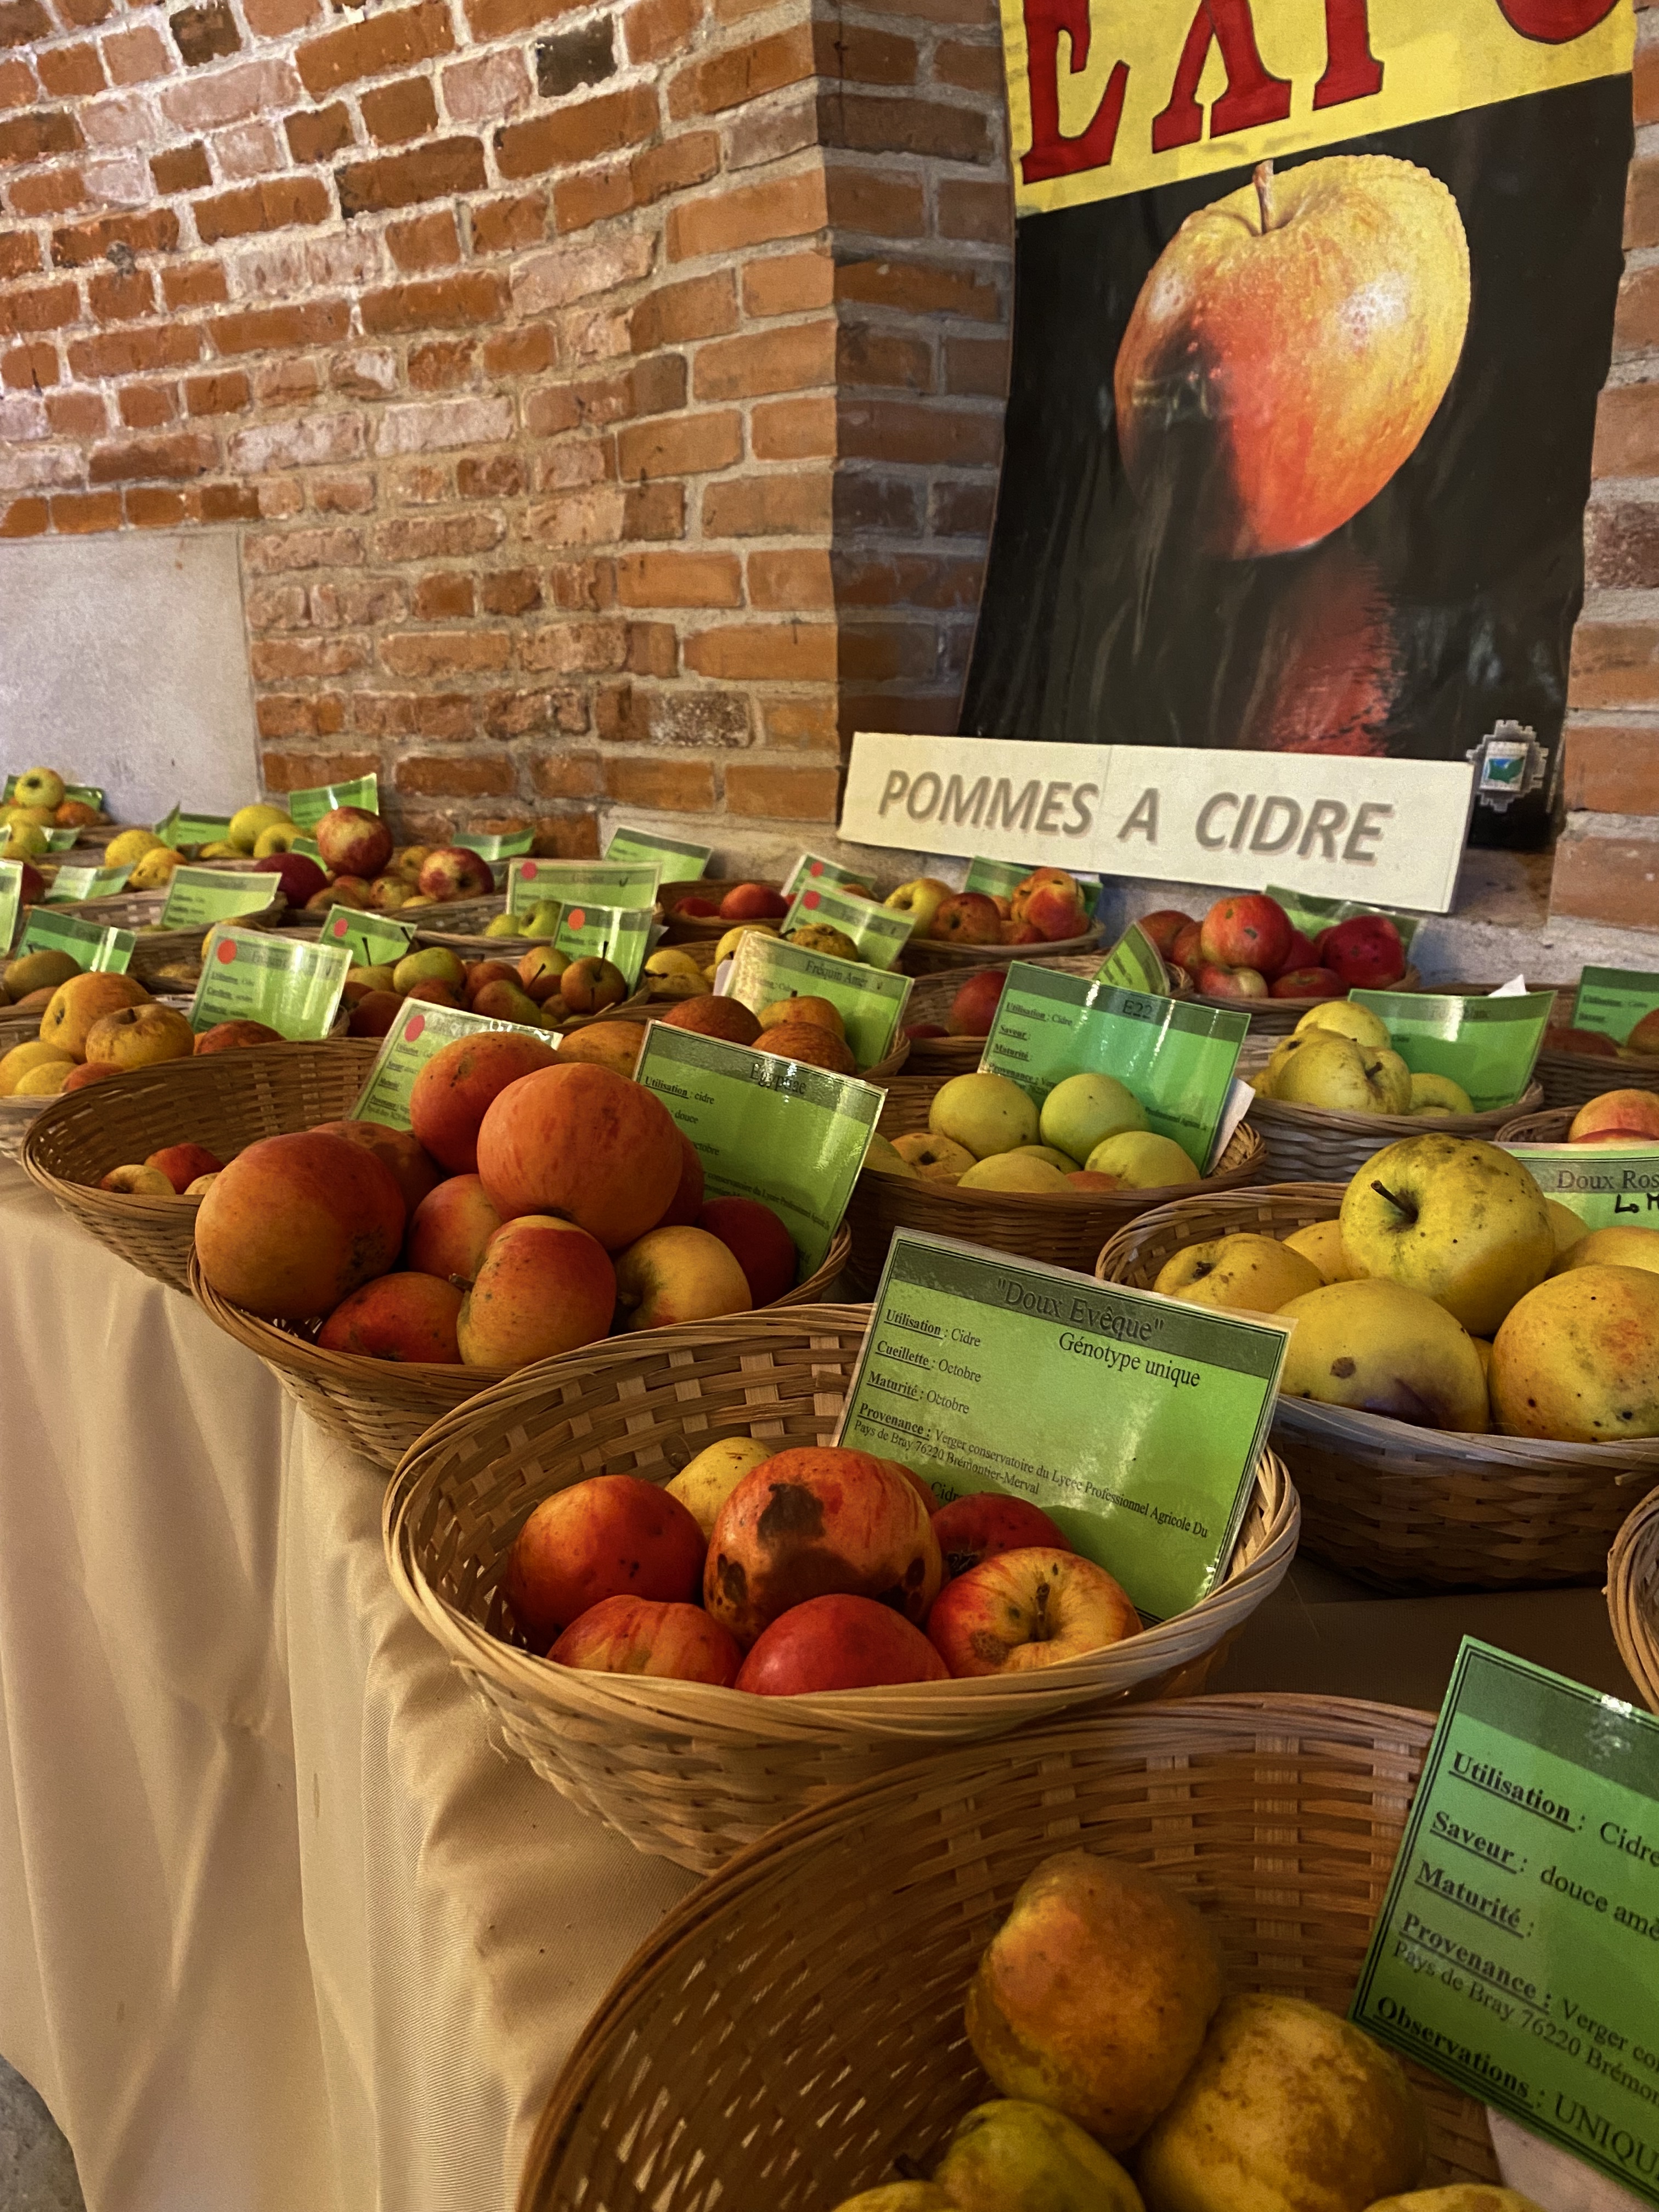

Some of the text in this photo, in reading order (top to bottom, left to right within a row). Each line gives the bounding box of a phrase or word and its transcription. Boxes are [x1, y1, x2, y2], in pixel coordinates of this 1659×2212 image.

[878, 770, 1393, 863] POMMES A CIDRE
[645, 1076, 688, 1096] Utilisation
[675, 1110, 699, 1124] douce
[693, 1141, 720, 1155] ctobre
[1556, 1170, 1659, 1189] Doux Ros
[885, 1309, 941, 1335] Utilisation
[951, 1328, 981, 1347] Cidre
[997, 1277, 1164, 1342] "Doux Evêque"
[868, 1370, 918, 1397] Maturité
[927, 1390, 969, 1414] Octobre
[877, 1340, 929, 1366] Cueillette
[938, 1359, 981, 1383] Octobre
[1059, 1332, 1200, 1388] Génotype unique
[854, 1420, 1040, 1494] Pays de Bray 76220 Brémontier-Merval
[859, 1402, 924, 1435] Provenance
[935, 1429, 967, 1451] Verger
[968, 1444, 1035, 1473] conservatoire
[1036, 1465, 1049, 1479] du
[1084, 1481, 1150, 1516] Professionnel
[1150, 1506, 1191, 1531] Agricole
[1193, 1521, 1208, 1538] Du
[931, 1481, 962, 1502] Cidr
[1453, 1751, 1571, 1822] Utilisation
[1600, 1821, 1659, 1867] Cidre
[1419, 1859, 1521, 1928] Maturité
[1432, 1810, 1515, 1864] Saveur
[1540, 1865, 1609, 1913] douce
[1393, 1940, 1435, 1976] Pays
[1441, 1969, 1464, 1991] de
[1469, 1983, 1515, 2022] Bray
[1521, 2008, 1582, 2057] 76220
[1403, 1911, 1536, 1999] Provenance
[1562, 1997, 1628, 2050] Verger
[1633, 2046, 1659, 2073] co
[1378, 1996, 1529, 2099] Observations
[1555, 2091, 1659, 2180] UNIQU
